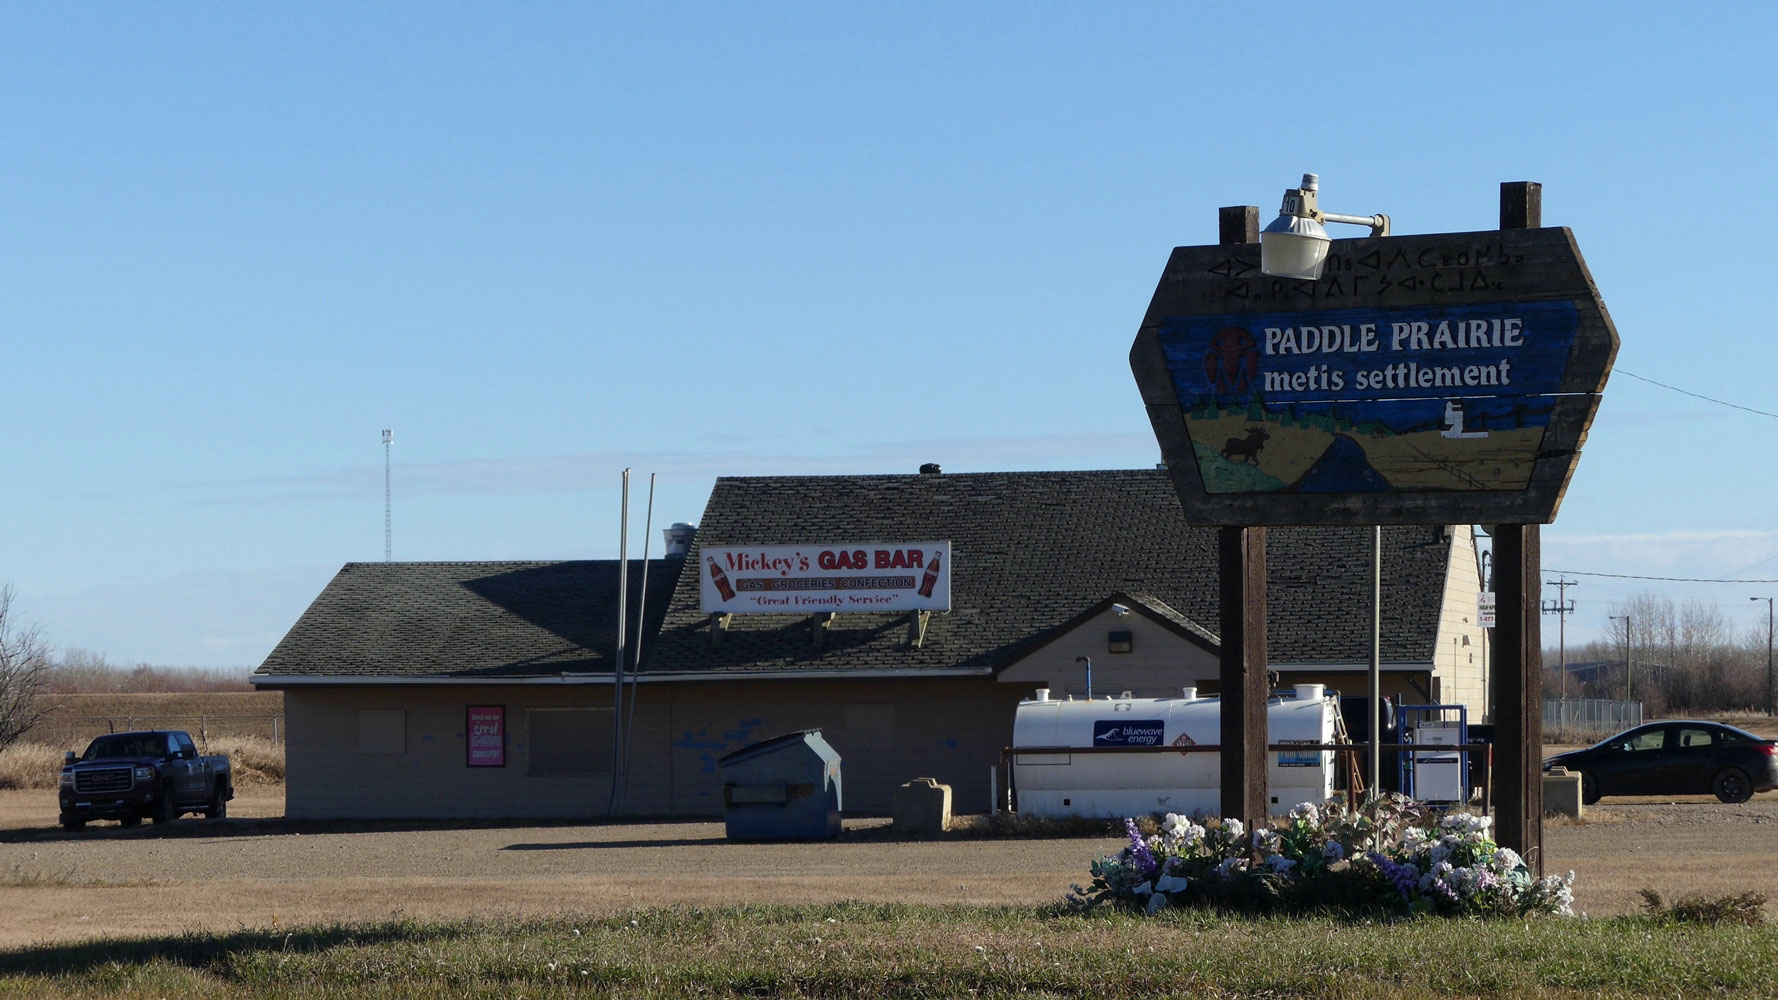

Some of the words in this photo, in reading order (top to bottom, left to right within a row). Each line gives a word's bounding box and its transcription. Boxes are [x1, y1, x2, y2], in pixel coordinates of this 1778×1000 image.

[1286, 199, 1296, 213] 10
[1264, 323, 1380, 355] PADDLE
[1391, 318, 1525, 351] PRAIRIE
[1263, 362, 1344, 392] metis
[1355, 358, 1512, 390] settlement
[725, 552, 810, 576] Mickey's
[818, 550, 868, 570] GAS
[874, 549, 924, 568] BAR
[741, 580, 765, 590] GAS
[772, 579, 836, 589] GROCERIES
[841, 578, 911, 588] CONFECTION
[795, 595, 844, 607] Friendly
[474, 721, 498, 737] great
[1122, 726, 1163, 736] bluewave
[1128, 735, 1157, 745] energy
